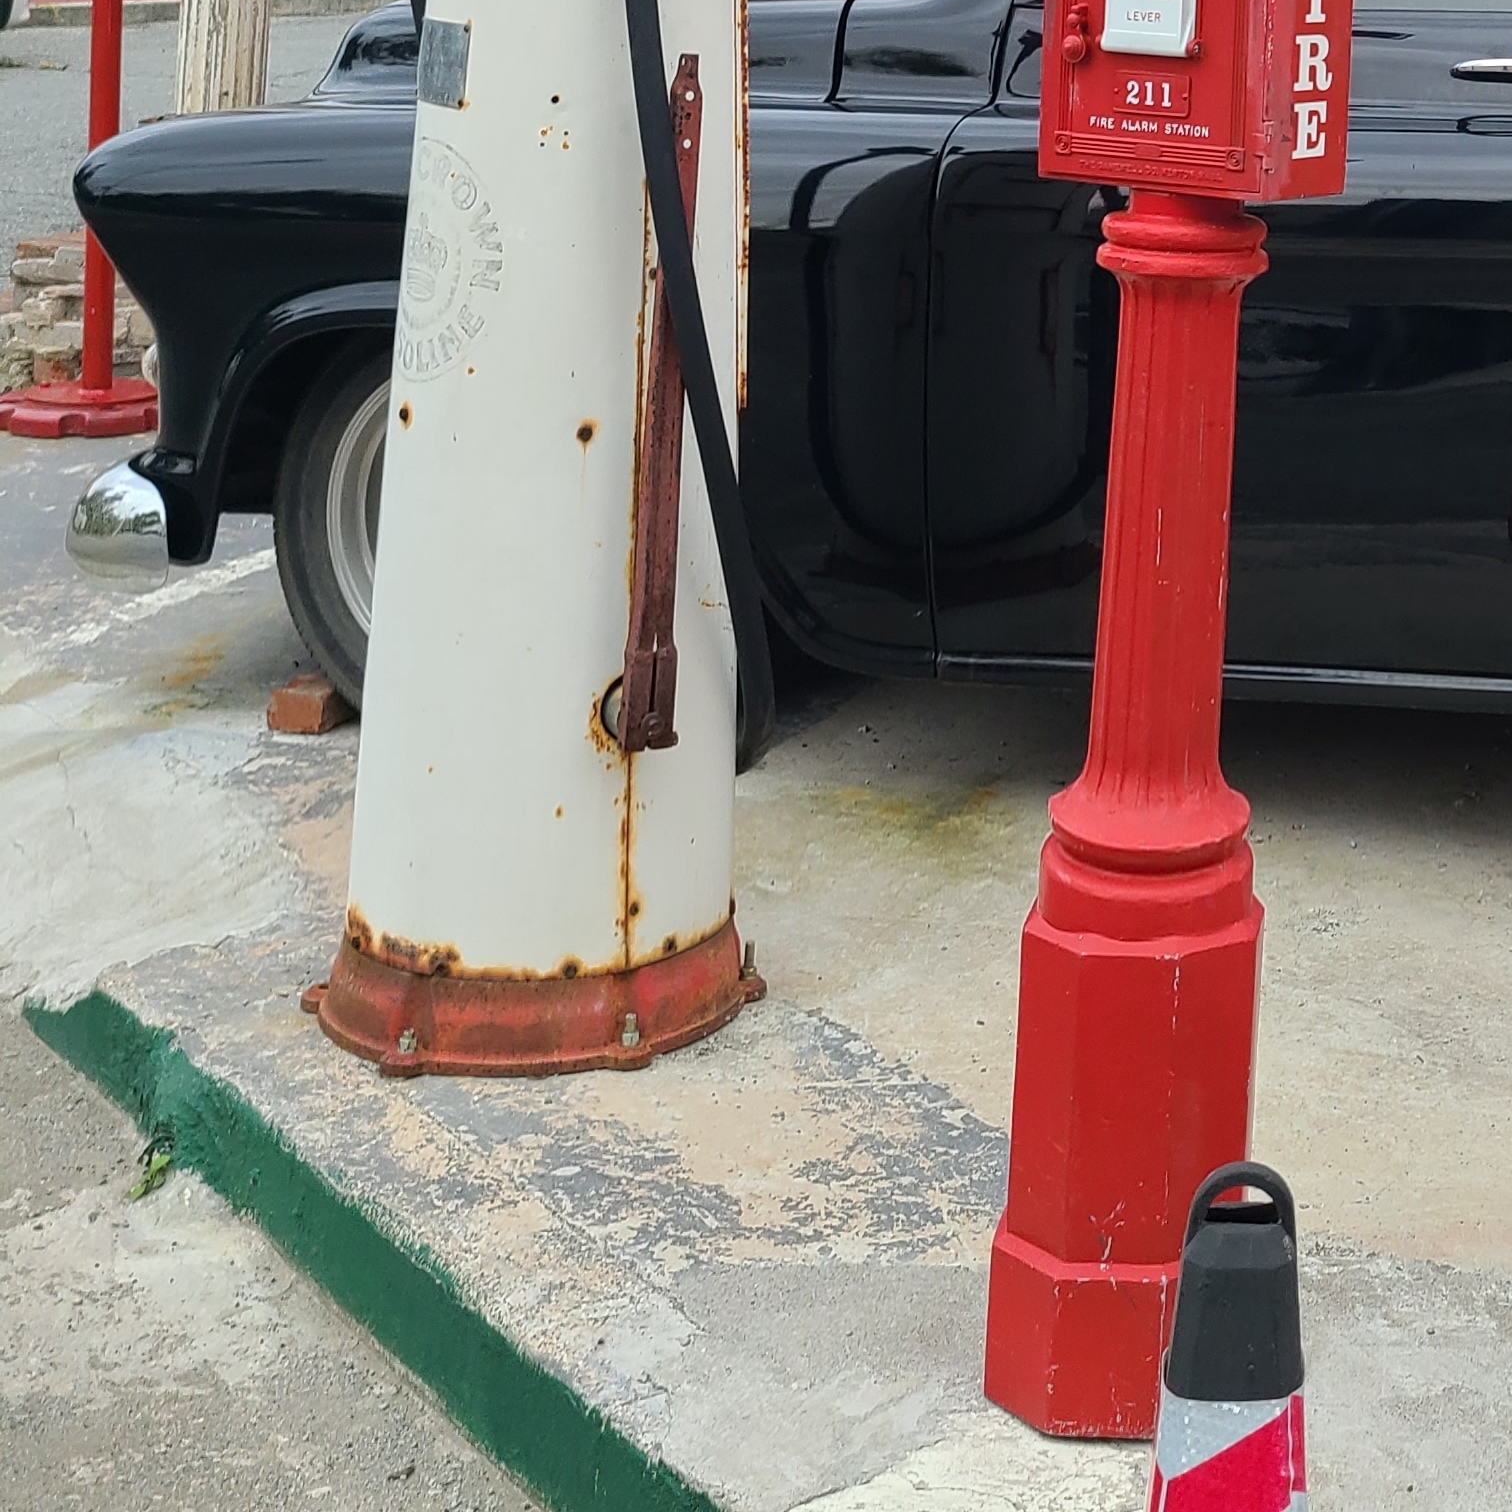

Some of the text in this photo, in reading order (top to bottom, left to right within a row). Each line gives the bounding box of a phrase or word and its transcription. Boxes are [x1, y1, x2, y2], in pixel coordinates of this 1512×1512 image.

[1126, 10, 1162, 23] LEVER
[1126, 80, 1172, 108] 211
[1089, 115, 1210, 138] FIRE ALARM STATION
[416, 144, 503, 292] CROWN
